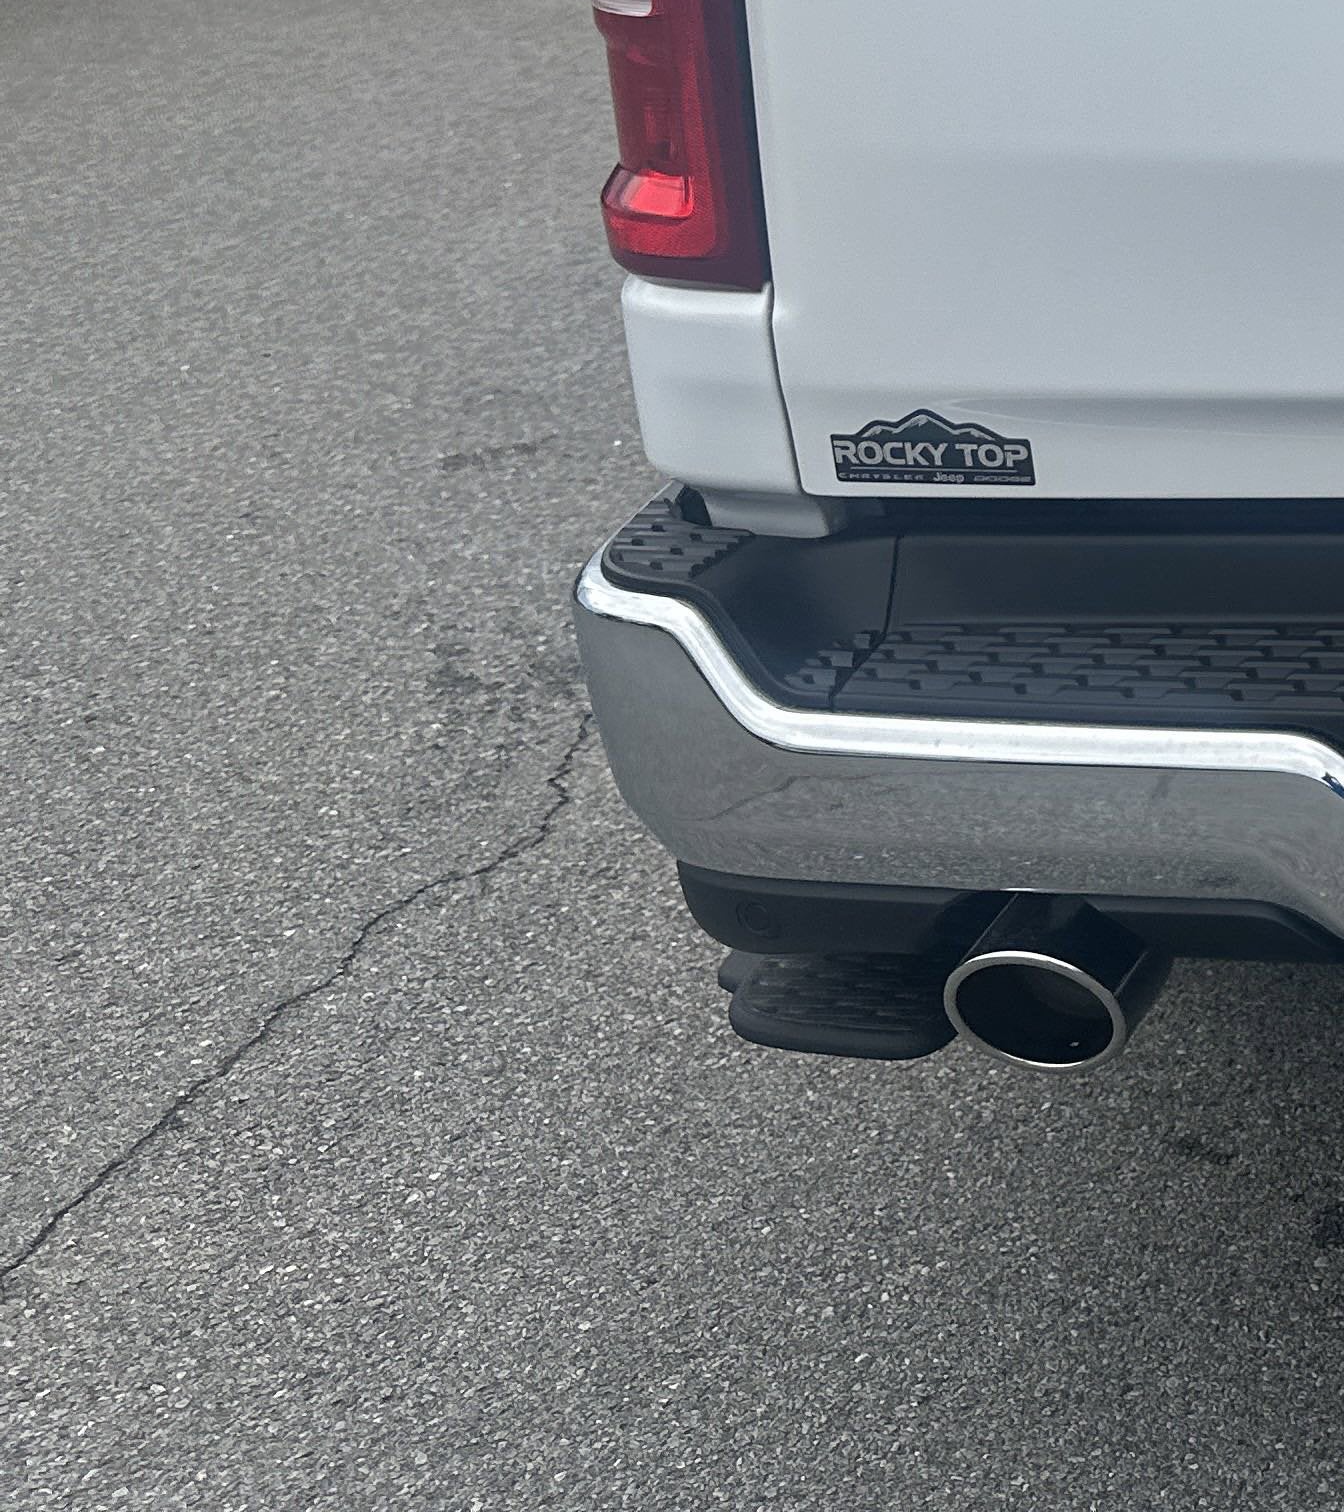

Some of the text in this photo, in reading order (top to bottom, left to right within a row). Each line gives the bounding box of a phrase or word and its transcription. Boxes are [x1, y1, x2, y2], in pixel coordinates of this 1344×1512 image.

[833, 440, 1029, 467] ROCKY TOP
[838, 471, 1033, 483] CHRYSLER Jeep DODGE
